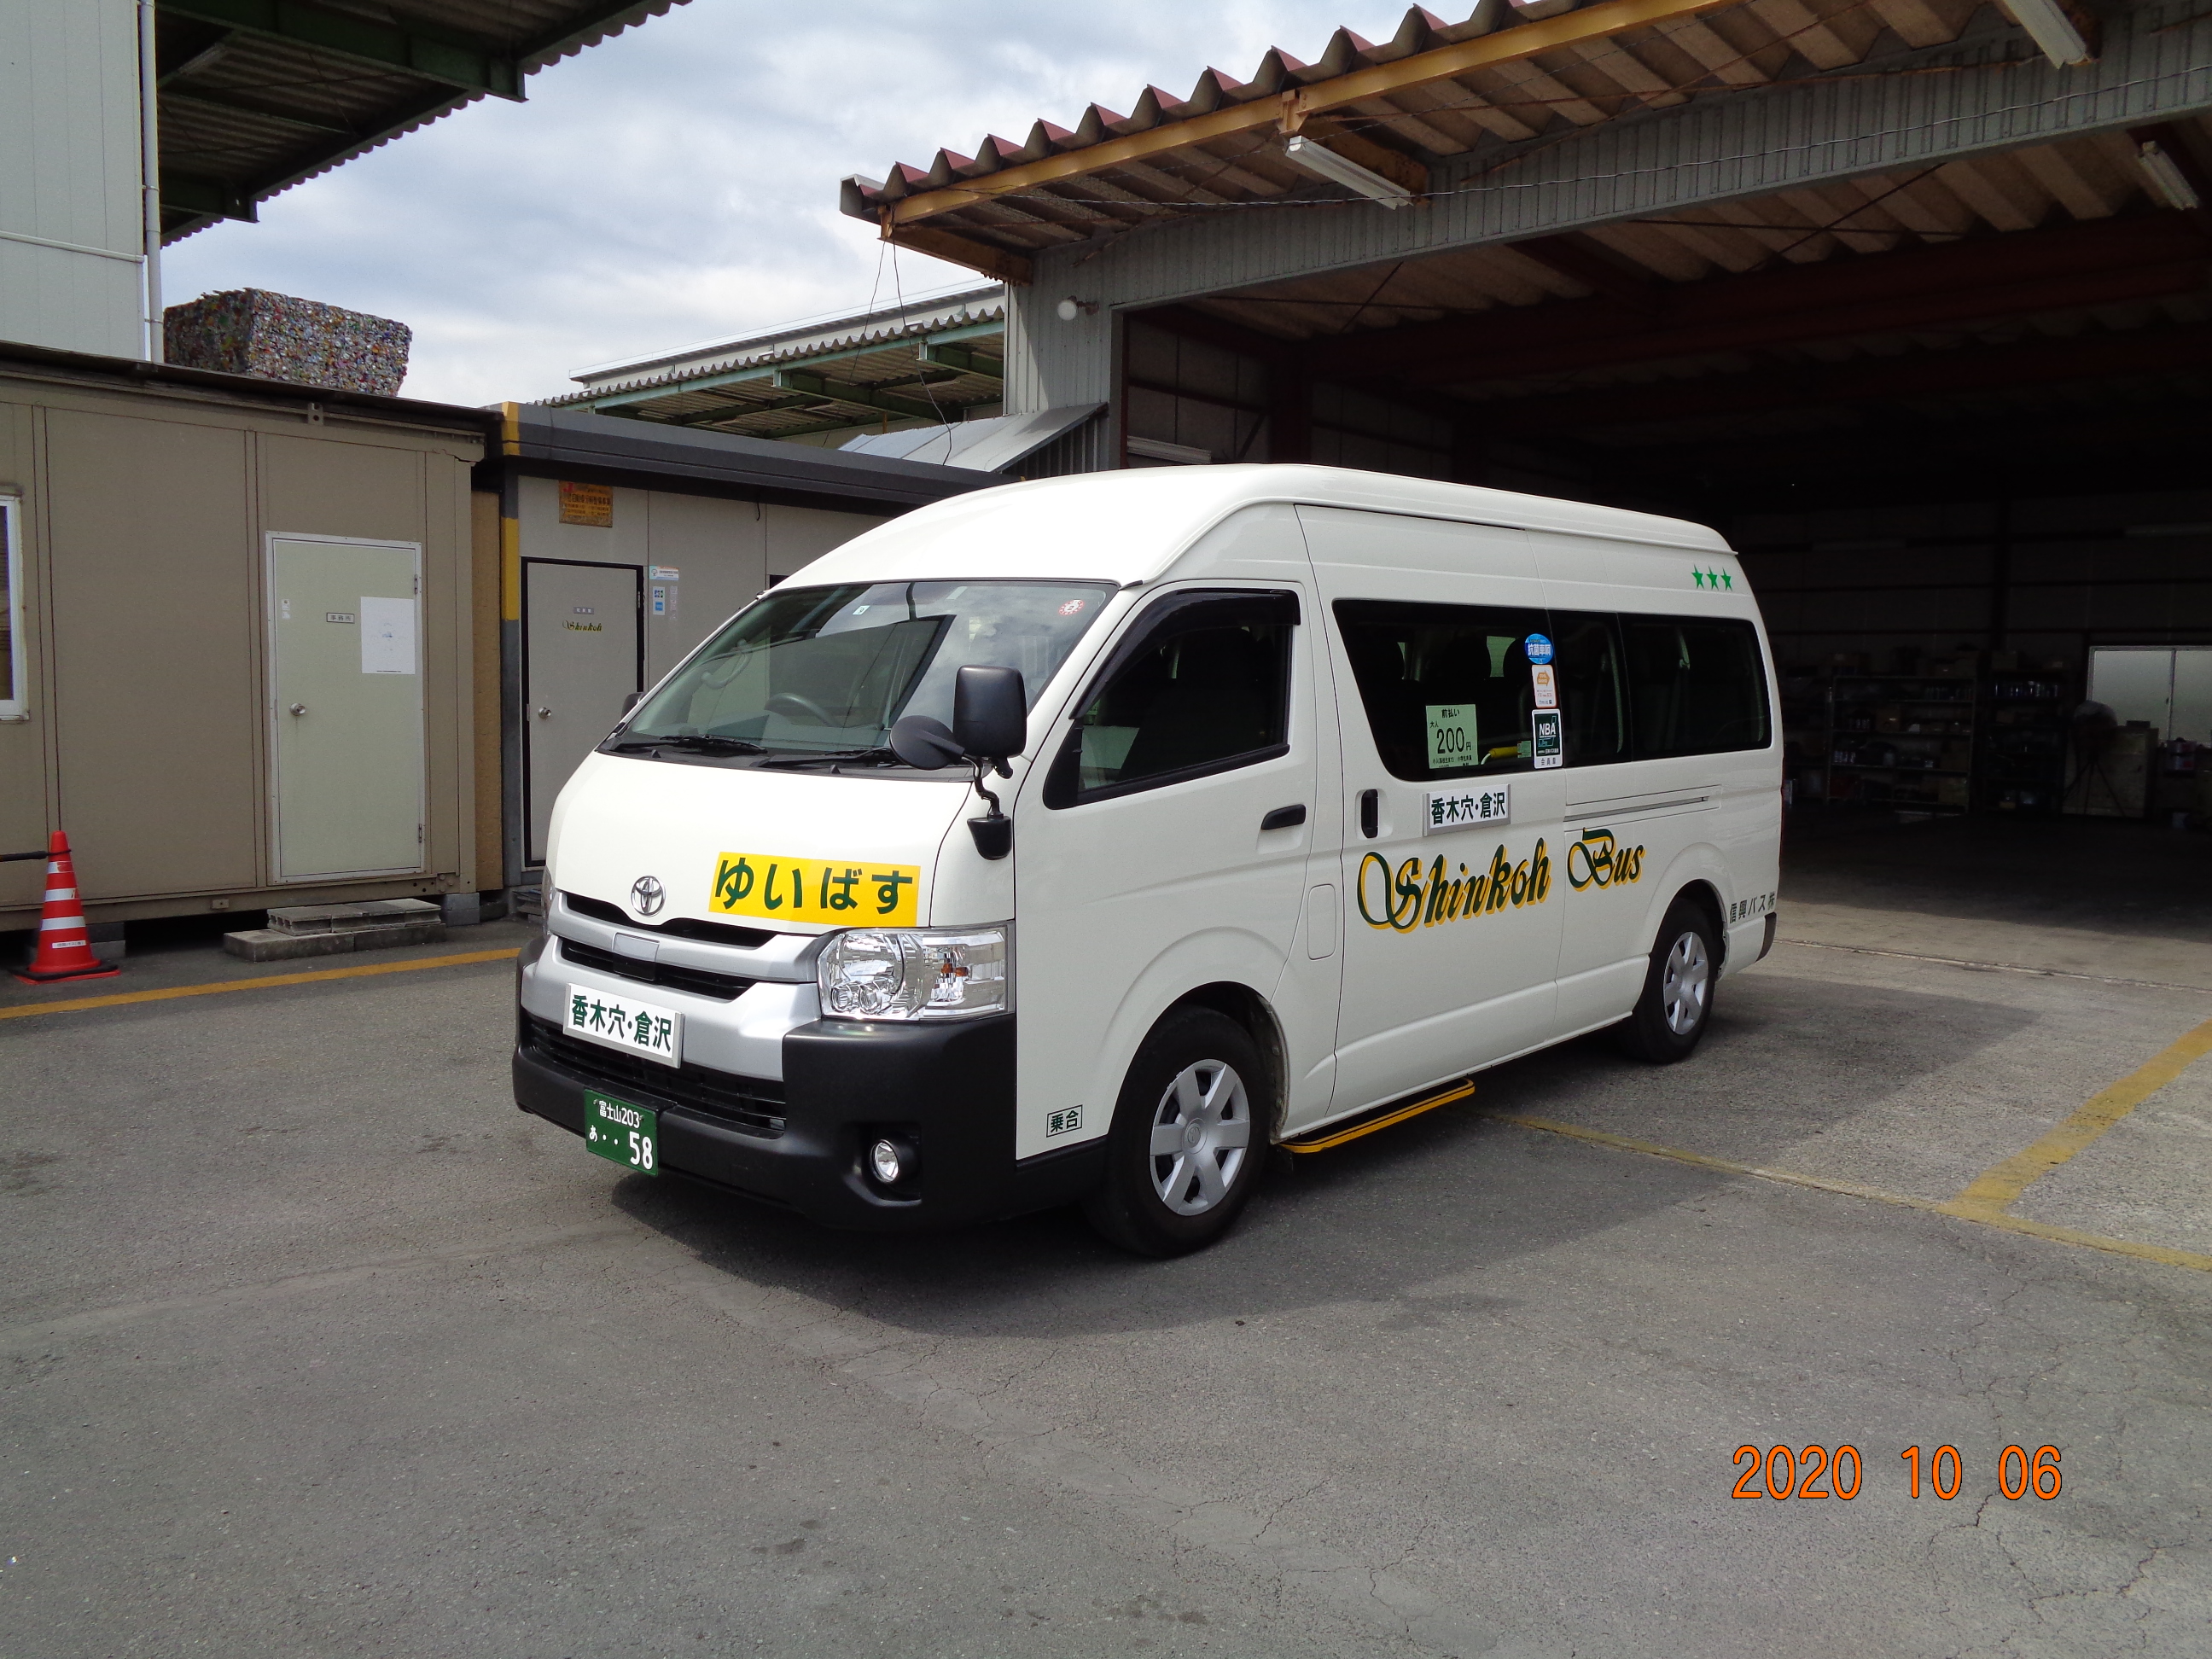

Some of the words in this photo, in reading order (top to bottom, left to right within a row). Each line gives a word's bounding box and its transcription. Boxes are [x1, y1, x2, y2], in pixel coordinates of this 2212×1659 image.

[562, 619, 602, 632] Shinkoh
[1441, 707, 1460, 719] 前払い
[1539, 723, 1557, 736] NBA
[1430, 791, 1506, 825] 香木穴・倉沢
[714, 856, 914, 915] ゆいばす
[1356, 836, 1552, 934] Shinkoh
[1567, 827, 1646, 893] Bus
[572, 994, 672, 1052] 香木穴・倉沢
[598, 1100, 641, 1129] 富士山203
[1050, 1109, 1080, 1133] 乗合
